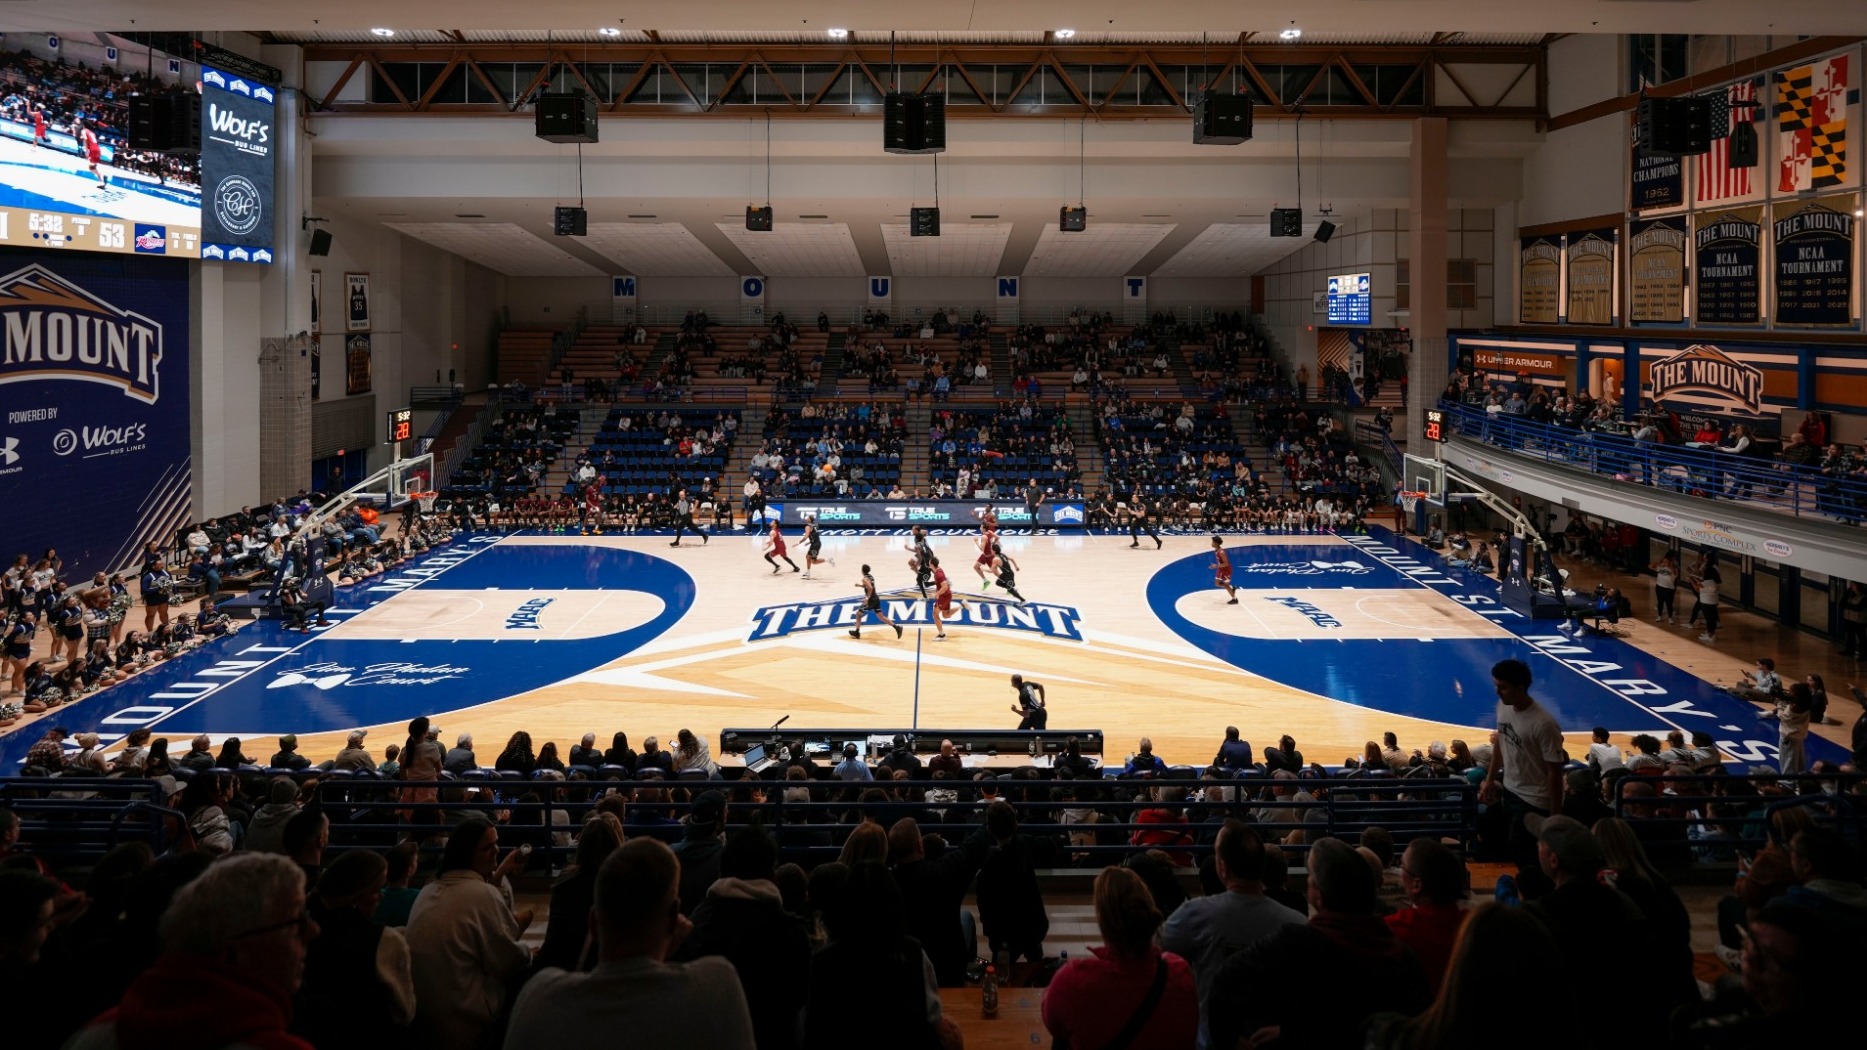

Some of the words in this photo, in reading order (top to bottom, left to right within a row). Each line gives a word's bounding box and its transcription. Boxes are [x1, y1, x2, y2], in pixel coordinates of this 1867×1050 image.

[1633, 163, 1679, 183] CHAMPIONS
[28, 212, 63, 233] 5:32
[1775, 216, 1800, 241] THE
[1803, 213, 1851, 236] MOUNT
[99, 222, 125, 248] 53
[1696, 226, 1718, 248] THE
[1720, 223, 1760, 243] MOUNT
[1716, 252, 1738, 265] NCAA
[1798, 246, 1825, 260] NCAA
[1701, 264, 1754, 278] TOURNAMENT
[1781, 259, 1844, 274] TOURNAMENT
[614, 279, 635, 296] M
[743, 278, 762, 297] O
[872, 279, 889, 297] U
[999, 279, 1016, 296] N
[1127, 279, 1142, 296] T
[353, 301, 363, 311] 35
[3, 310, 154, 385] MOUNT
[1515, 358, 1552, 369] ARMOUR
[1653, 360, 1687, 394] THE
[1691, 360, 1759, 404] MOUNT
[8, 409, 47, 425] POWERED
[47, 407, 58, 420] BY
[398, 410, 411, 422] 5:32
[1428, 411, 1441, 422] 5:32
[82, 422, 147, 450] WOLF'S
[396, 422, 409, 440] 28
[1427, 422, 1440, 441] 28
[126, 443, 146, 452] LINES
[1713, 523, 1733, 534] PNC
[1682, 525, 1712, 541] SPORTS
[1713, 534, 1757, 552] COMPLEX
[1341, 535, 1464, 587] MOUNT
[1450, 594, 1524, 624] ST.
[759, 603, 869, 636] THE
